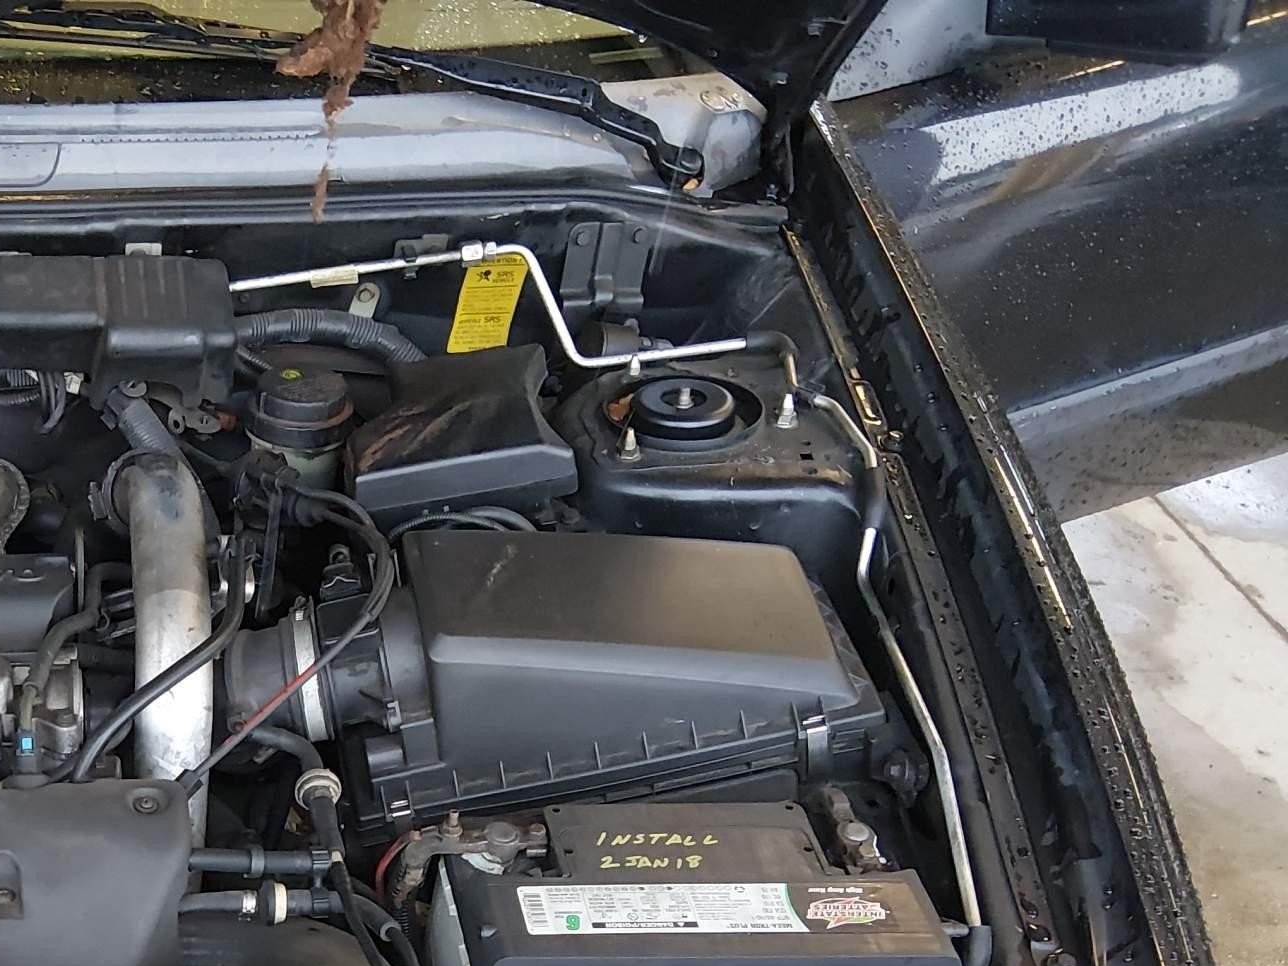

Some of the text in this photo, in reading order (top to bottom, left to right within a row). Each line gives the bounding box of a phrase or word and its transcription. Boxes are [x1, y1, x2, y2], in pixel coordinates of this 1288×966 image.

[596, 831, 719, 847] INSTALL
[599, 854, 703, 870] 2 JAN 18
[565, 914, 580, 930] 6
[812, 910, 884, 919] INTERSTATE
